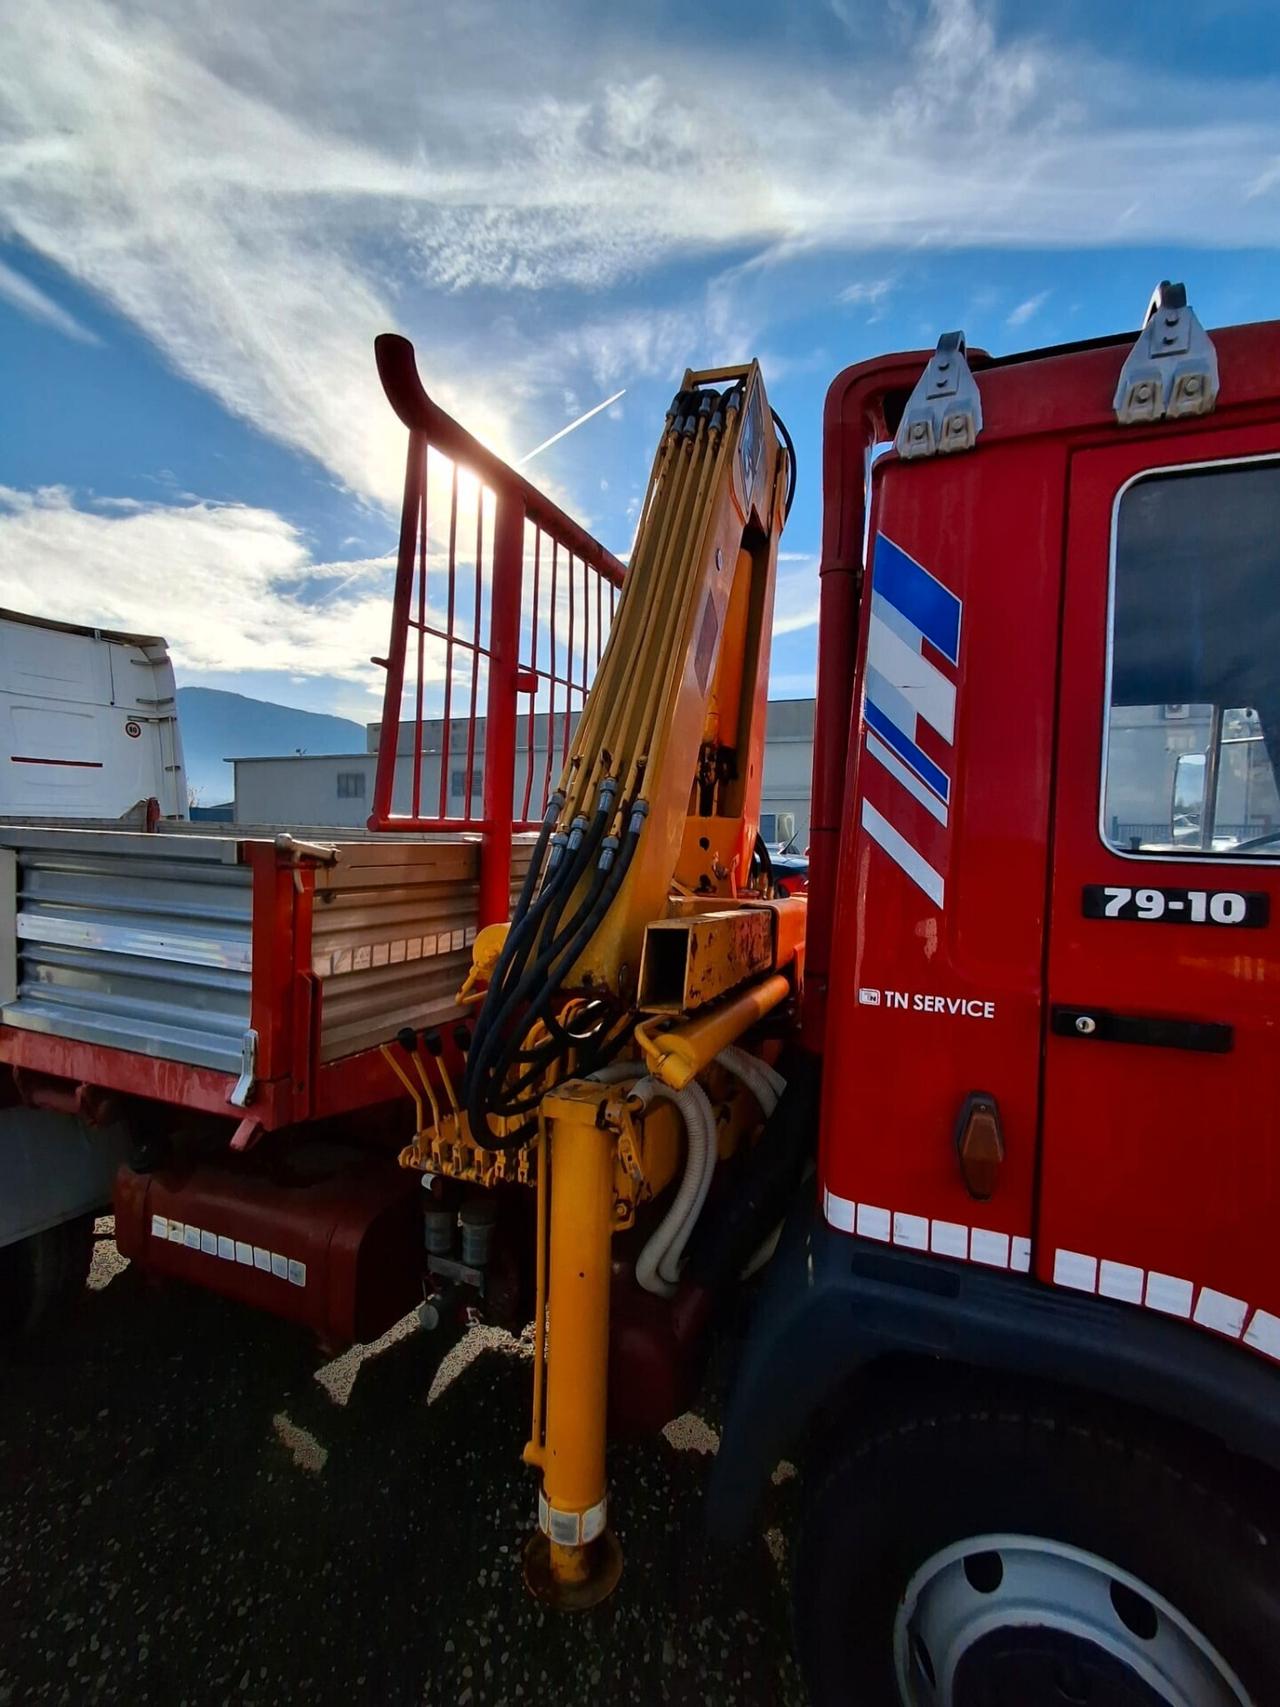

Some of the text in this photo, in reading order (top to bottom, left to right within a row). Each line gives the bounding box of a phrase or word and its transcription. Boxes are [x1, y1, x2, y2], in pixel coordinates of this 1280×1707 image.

[1104, 887, 1246, 924] 79-10
[884, 991, 995, 1018] TN SERVICE
